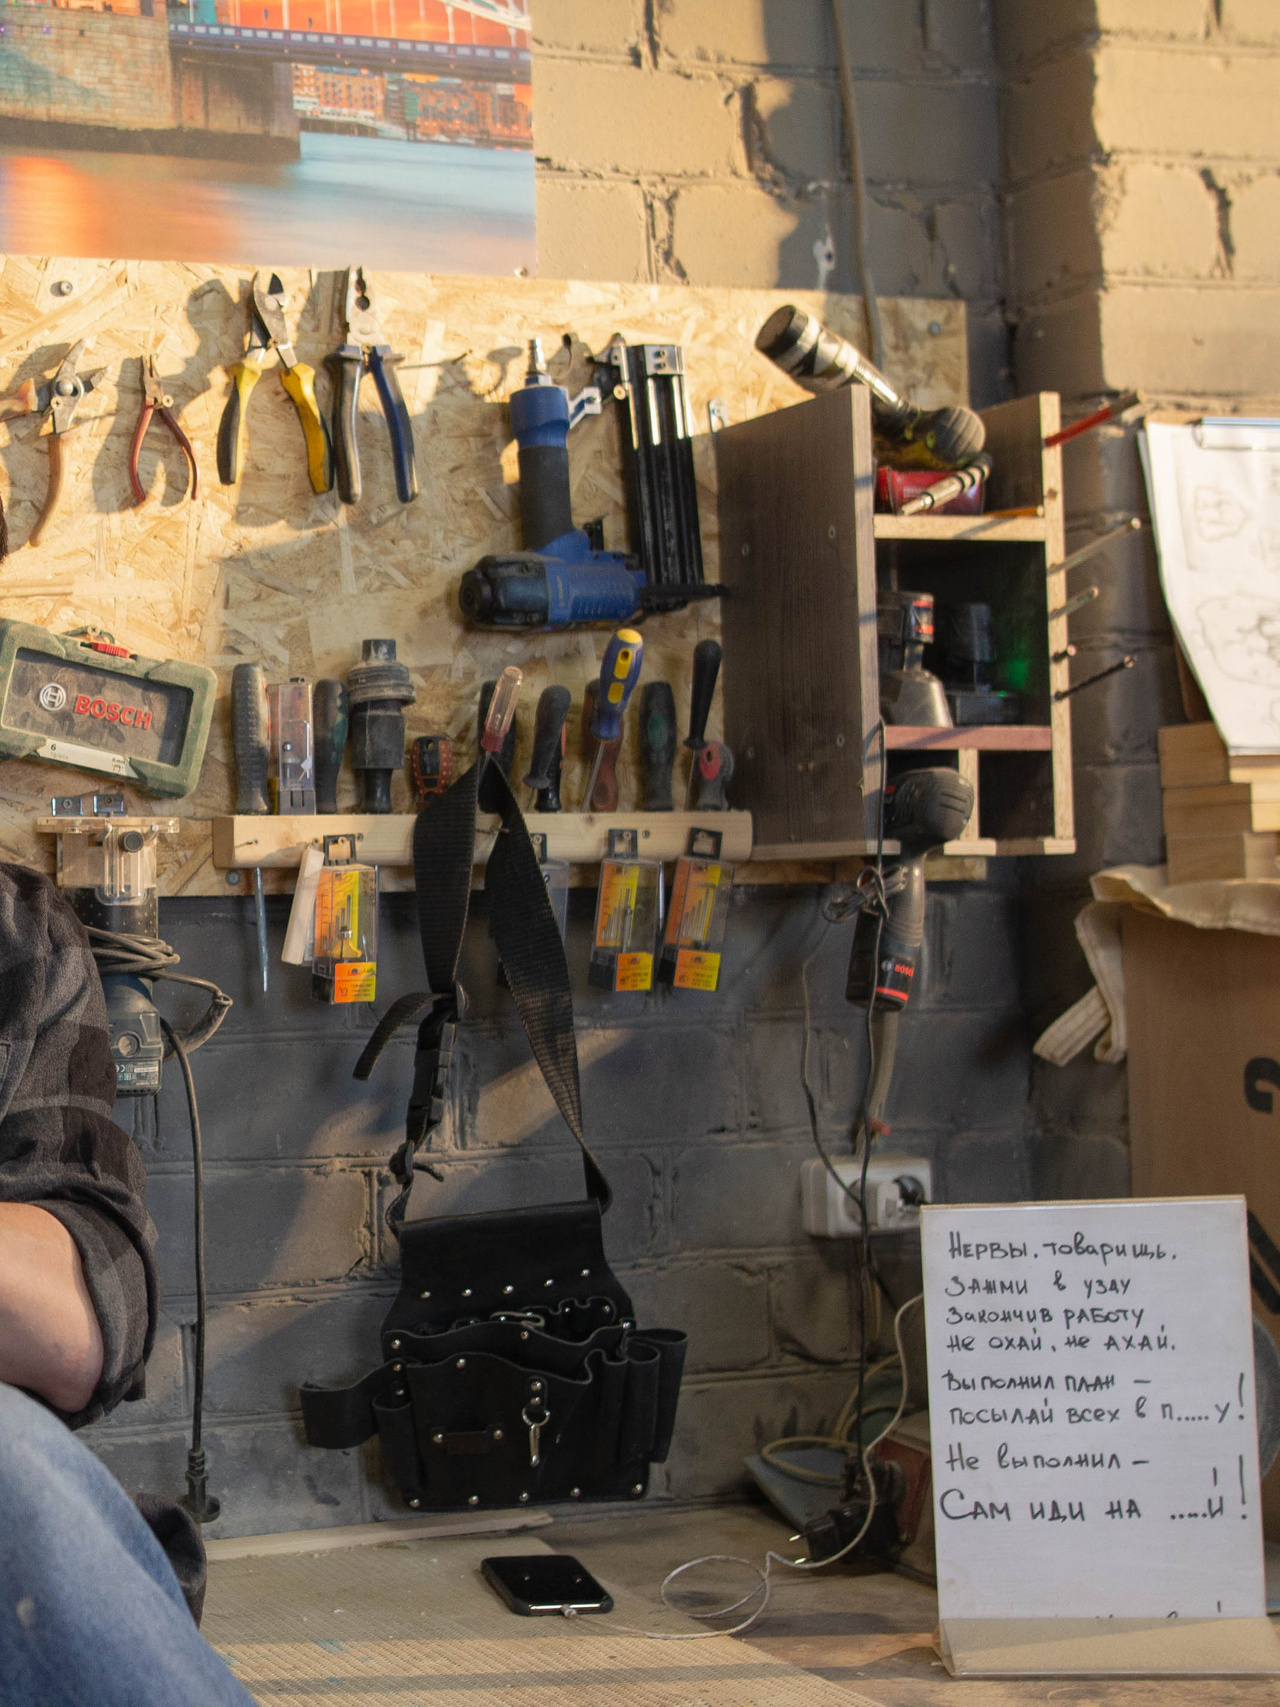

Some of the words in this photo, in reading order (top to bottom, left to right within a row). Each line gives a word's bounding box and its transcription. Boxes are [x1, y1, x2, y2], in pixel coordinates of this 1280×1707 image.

[74, 694, 152, 730] BOSCH
[945, 1441, 980, 1472] Не
[997, 1442, 1121, 1470] выполнил
